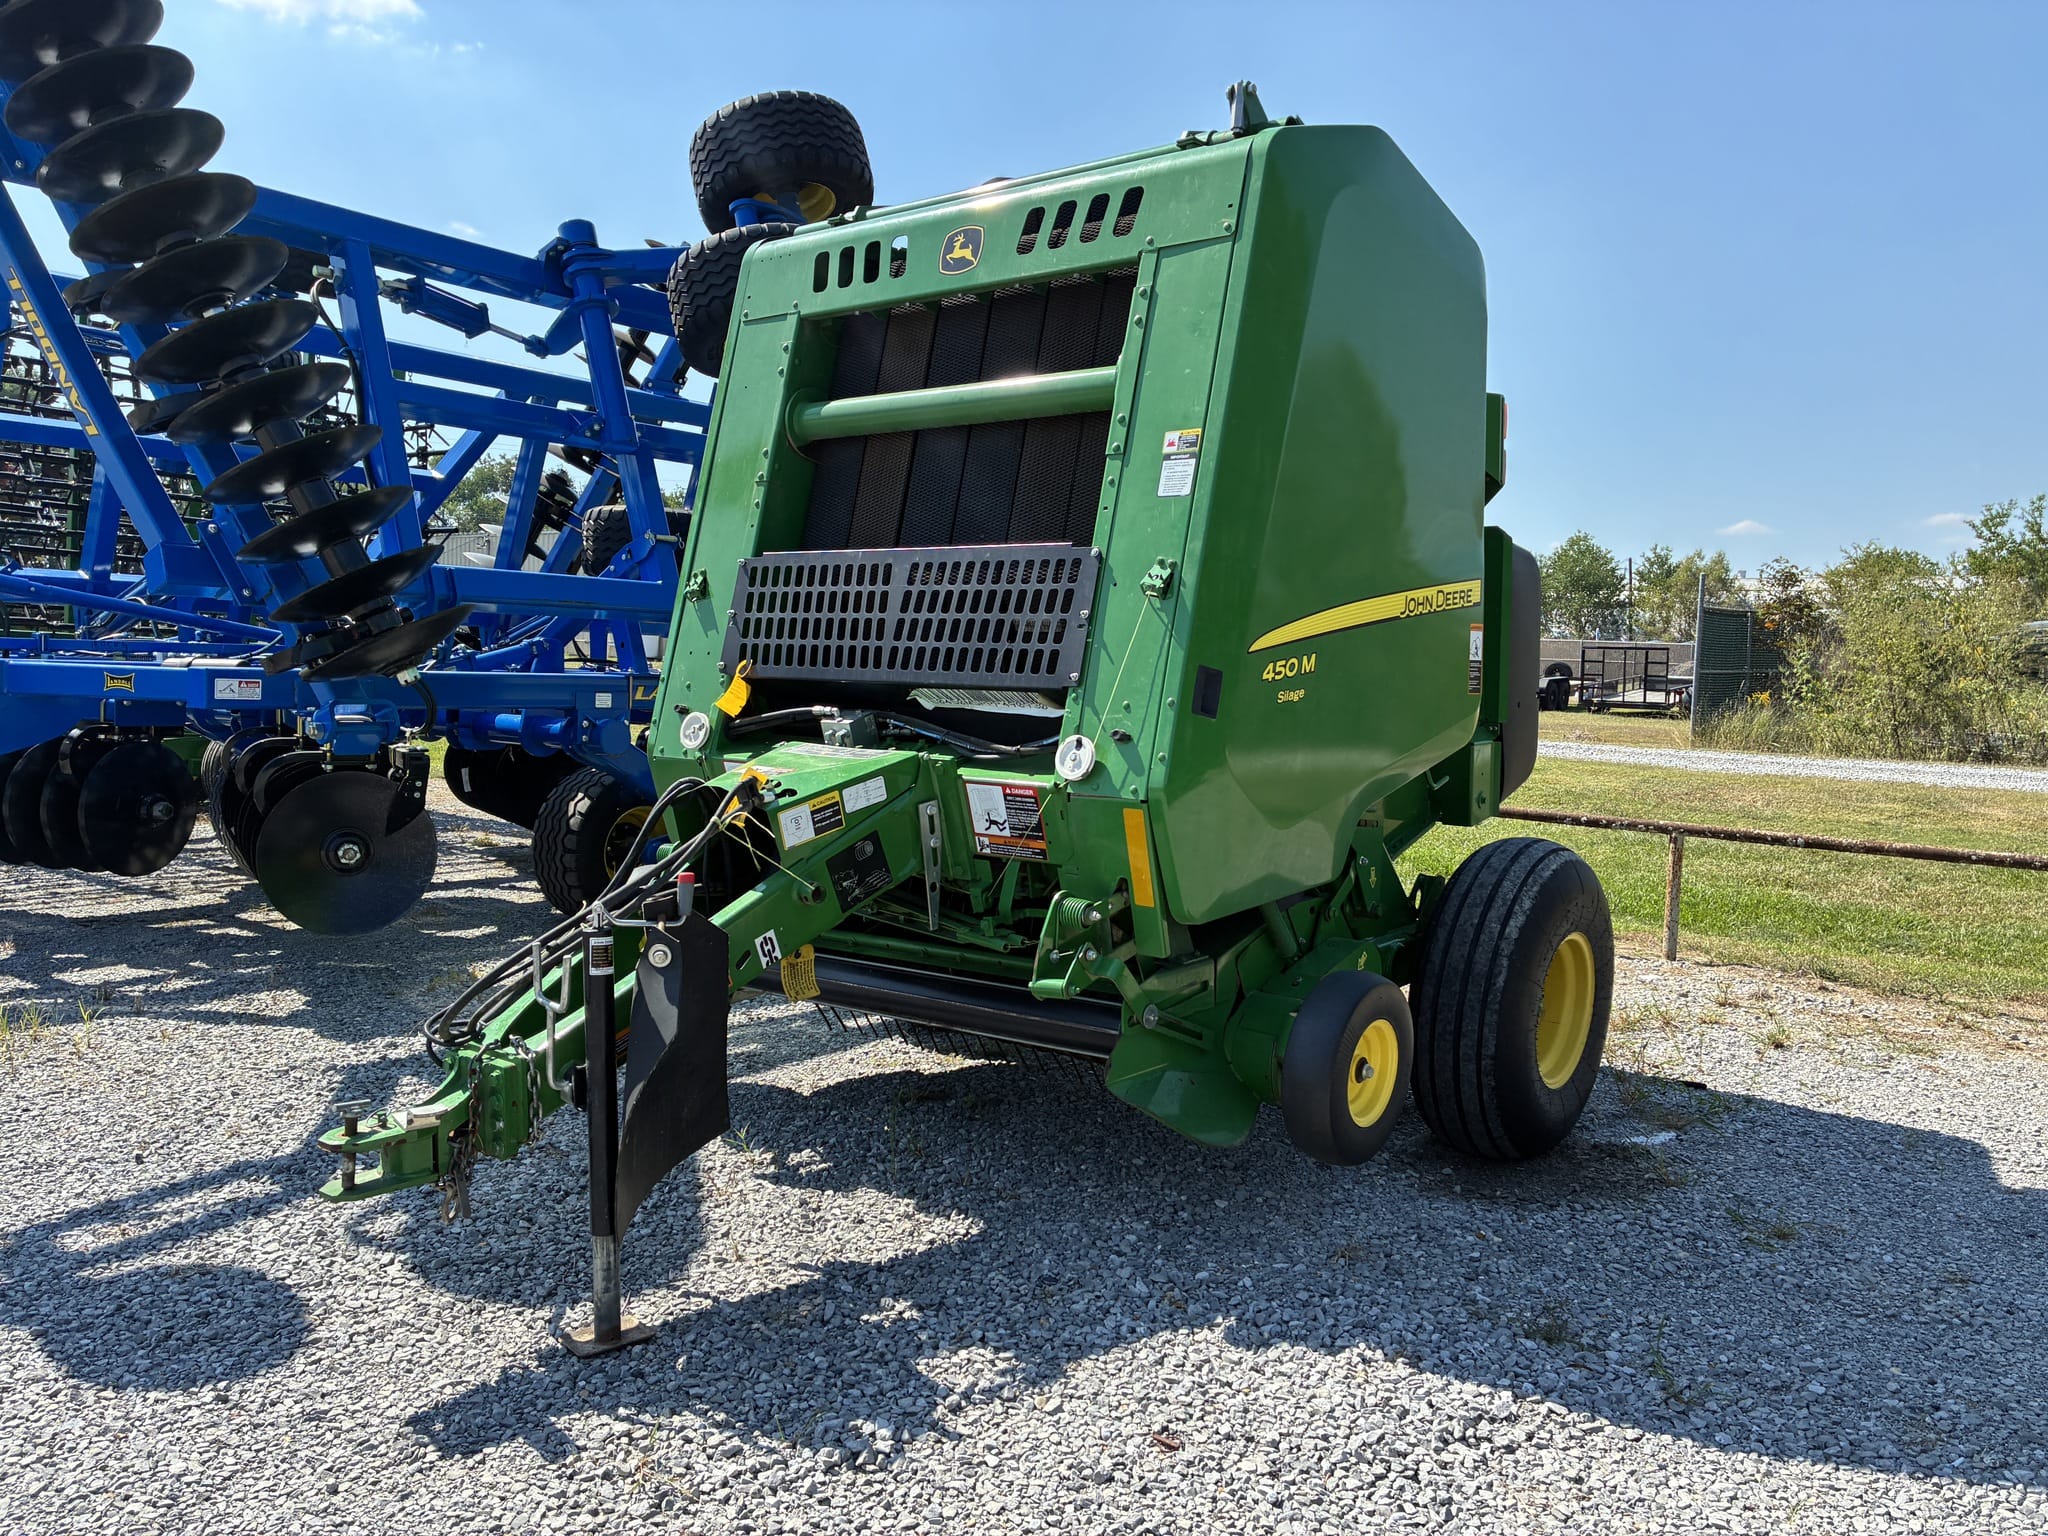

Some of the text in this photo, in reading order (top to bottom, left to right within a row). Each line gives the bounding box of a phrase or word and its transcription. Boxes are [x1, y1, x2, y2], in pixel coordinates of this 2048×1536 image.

[8, 266, 100, 437] LANDOLL
[1400, 588, 1473, 616] JOHN DEERE
[1262, 653, 1317, 682] 450 M
[1277, 688, 1305, 704] Silage
[816, 796, 836, 806] CAUTION
[1011, 788, 1034, 796] DANGER
